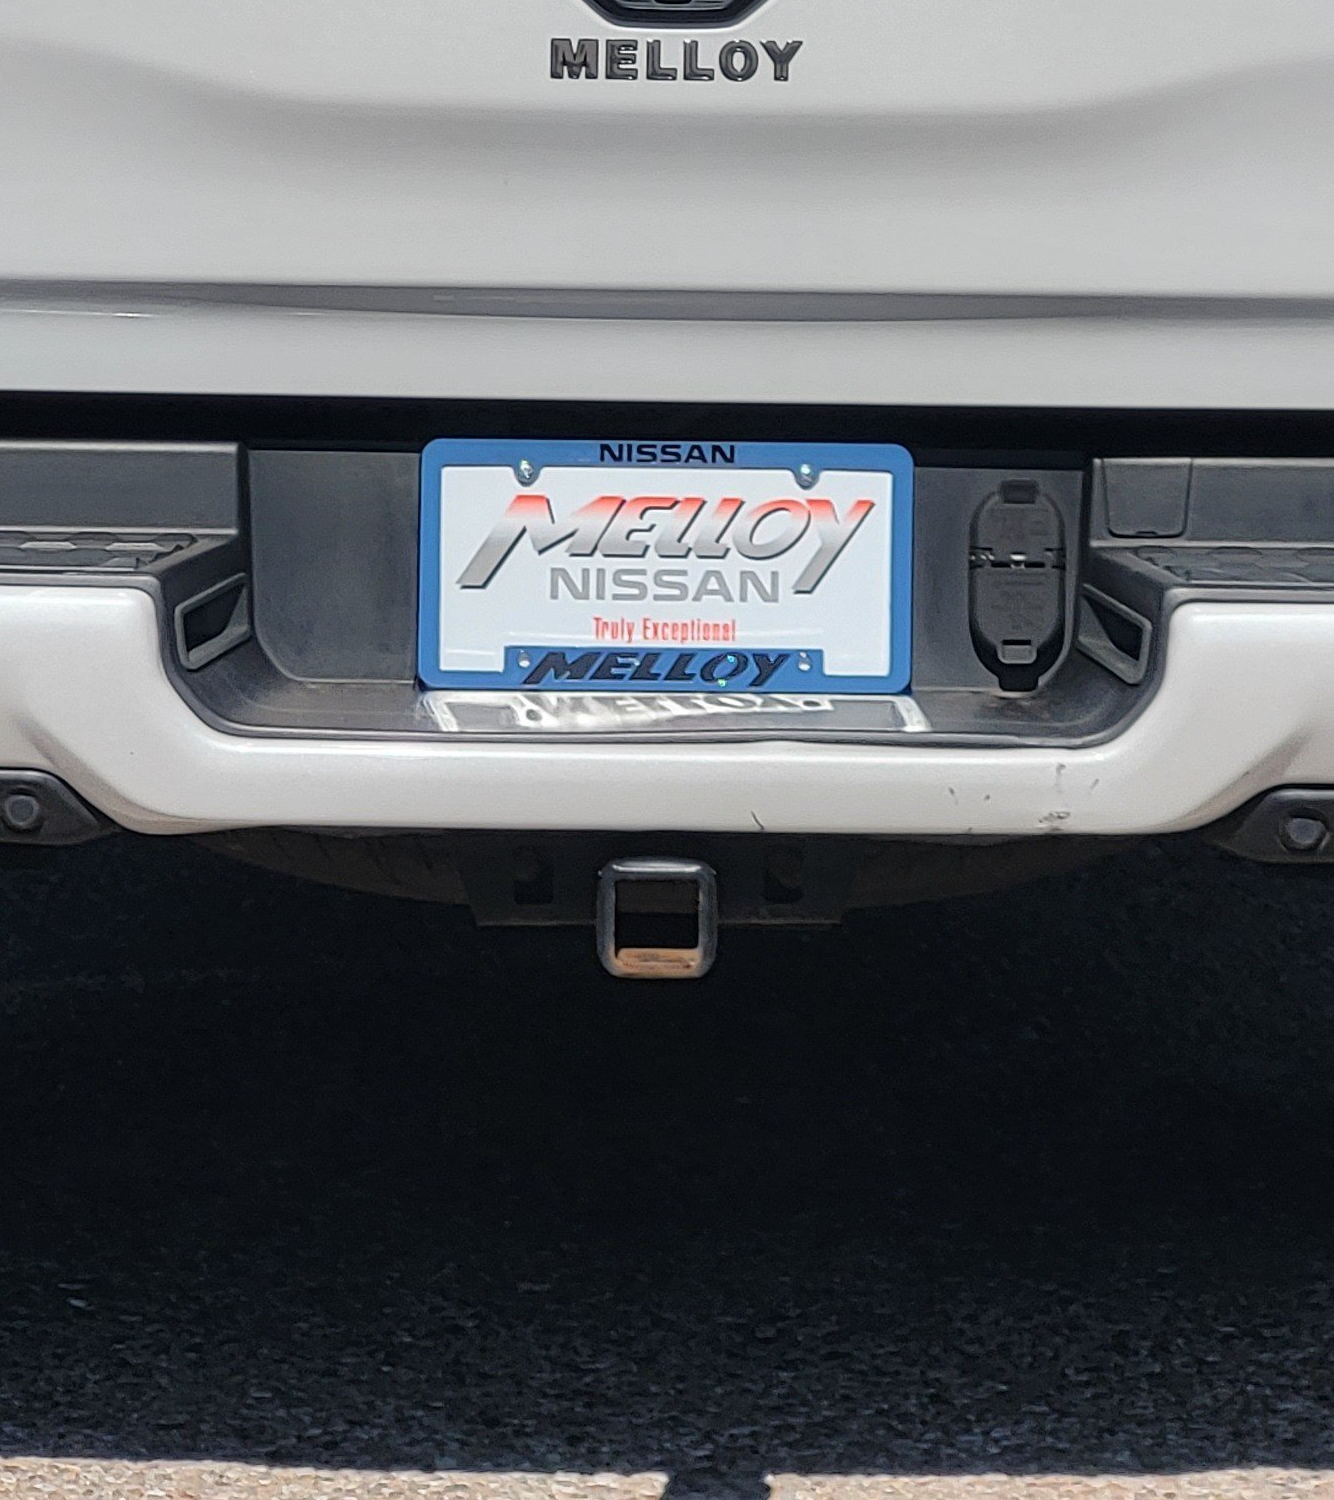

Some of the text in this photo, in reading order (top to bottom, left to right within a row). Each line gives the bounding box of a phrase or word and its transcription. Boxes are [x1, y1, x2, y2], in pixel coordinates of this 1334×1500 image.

[550, 38, 803, 81] MELLOY
[599, 443, 735, 464] NISSAN
[456, 494, 875, 594] MELLOY
[549, 567, 780, 603] NISSAN
[593, 617, 736, 644] Truly Exceptional
[521, 651, 789, 686] MELLOY
